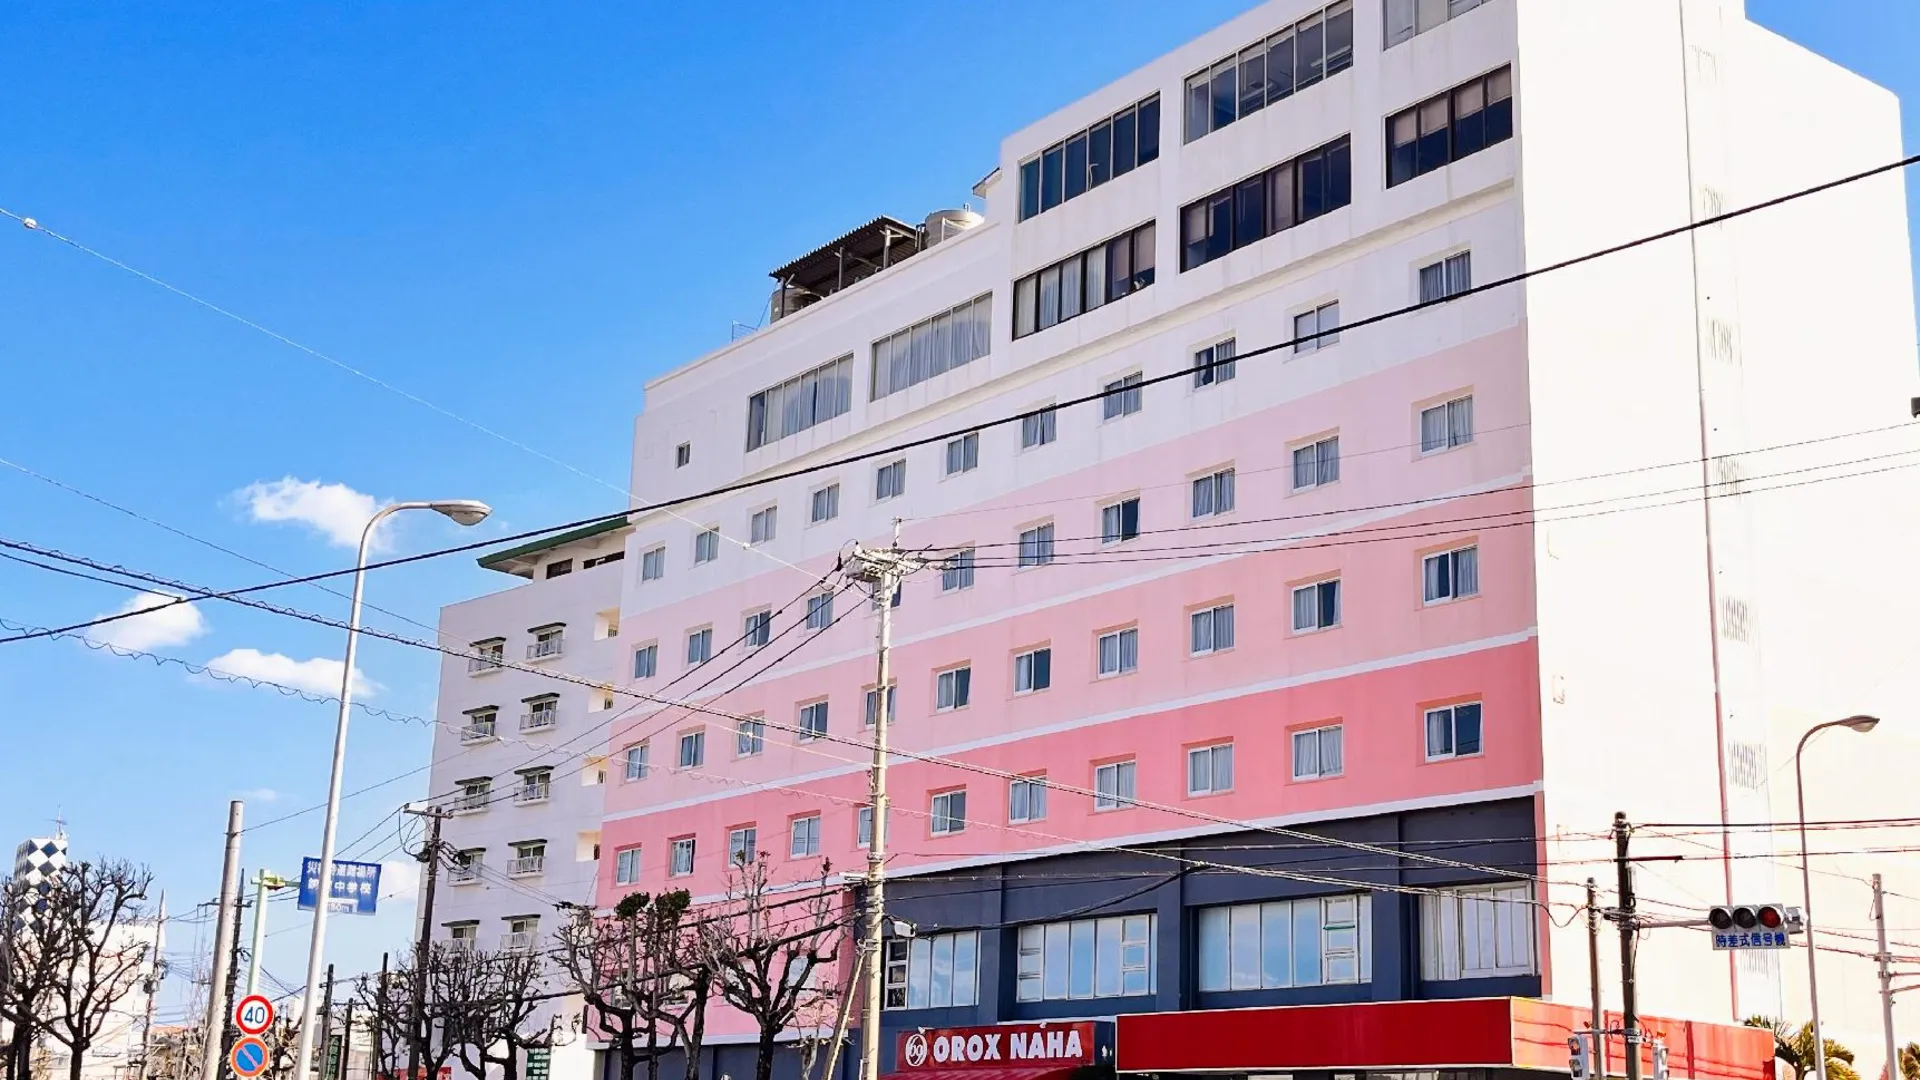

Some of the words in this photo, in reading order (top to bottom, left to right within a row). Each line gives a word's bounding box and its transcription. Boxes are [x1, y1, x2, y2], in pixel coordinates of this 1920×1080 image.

[1715, 932, 1786, 948] 時差式信号機
[244, 1006, 265, 1024] 40
[933, 1034, 1002, 1063] OROX
[1010, 1030, 1083, 1059] NAHA
